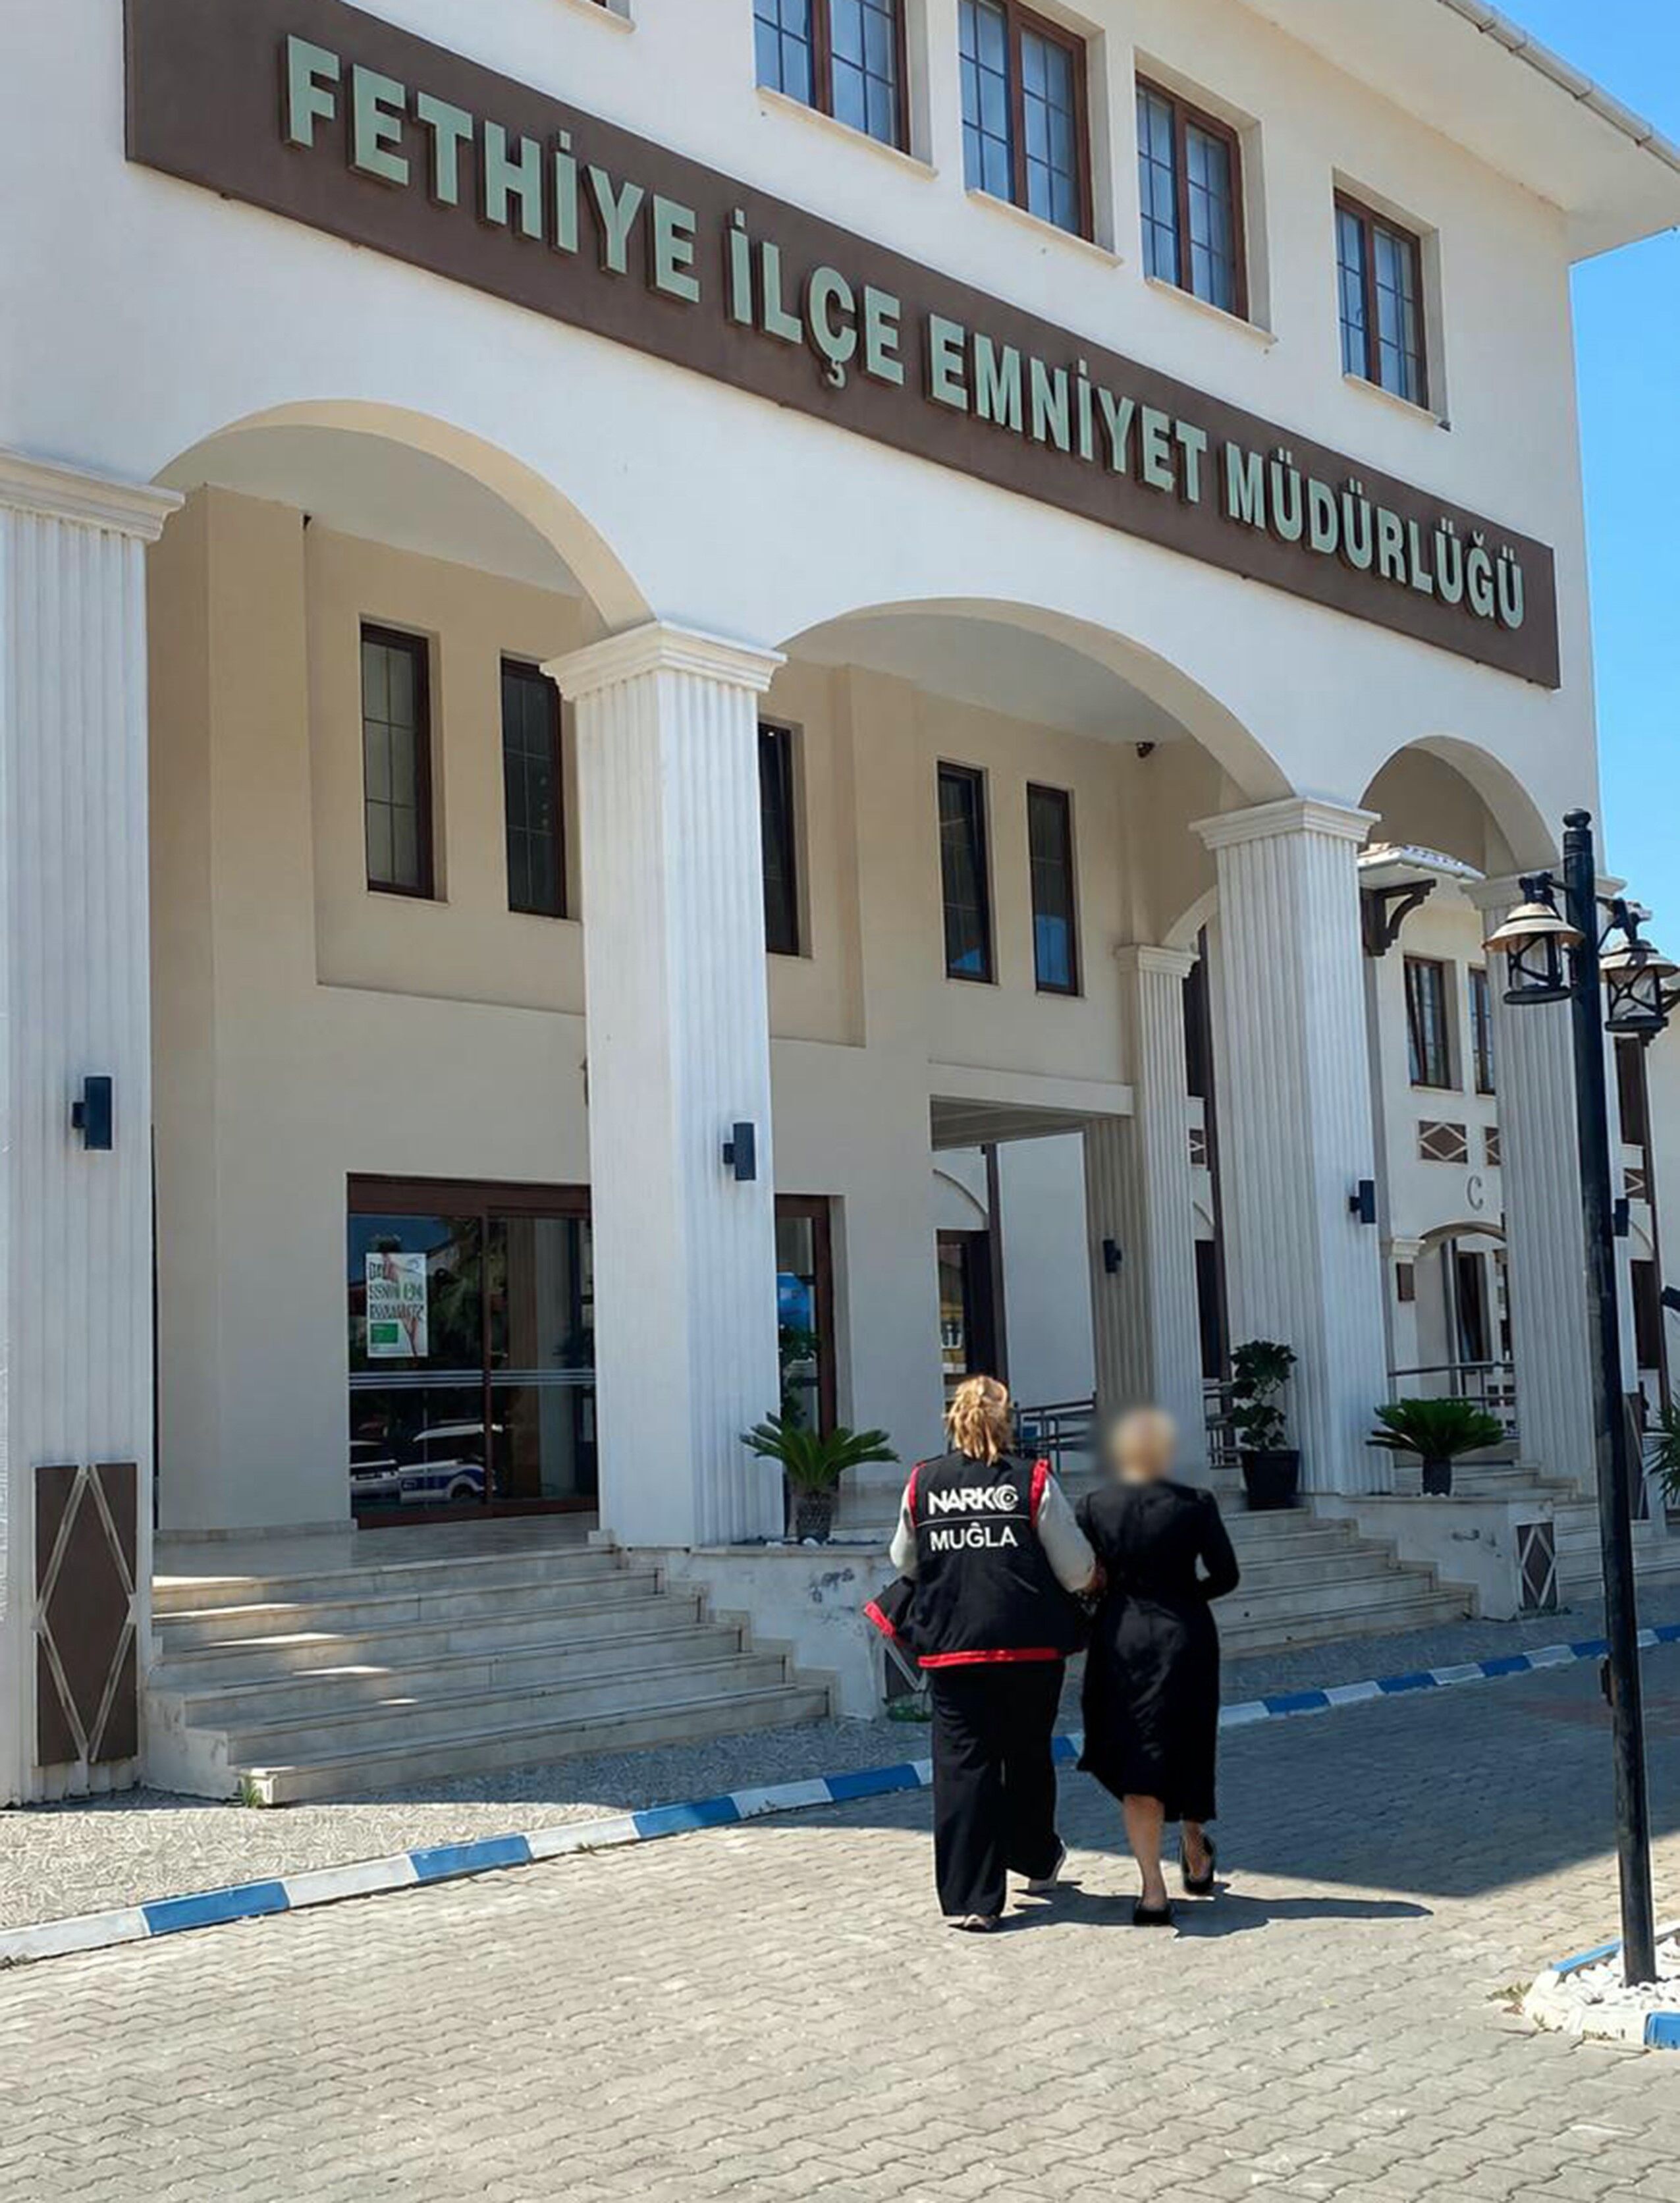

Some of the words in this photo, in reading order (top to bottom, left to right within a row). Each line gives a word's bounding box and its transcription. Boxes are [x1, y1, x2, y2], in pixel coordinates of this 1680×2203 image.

[286, 34, 700, 304] FETHİYE
[729, 207, 904, 389] İLÇE
[929, 313, 1208, 504] EMNİYET
[1225, 441, 1525, 630] MÜDÜRLÜĞÜ
[1467, 1175, 1483, 1210] C
[929, 1521, 1018, 1552] MUĞLA
